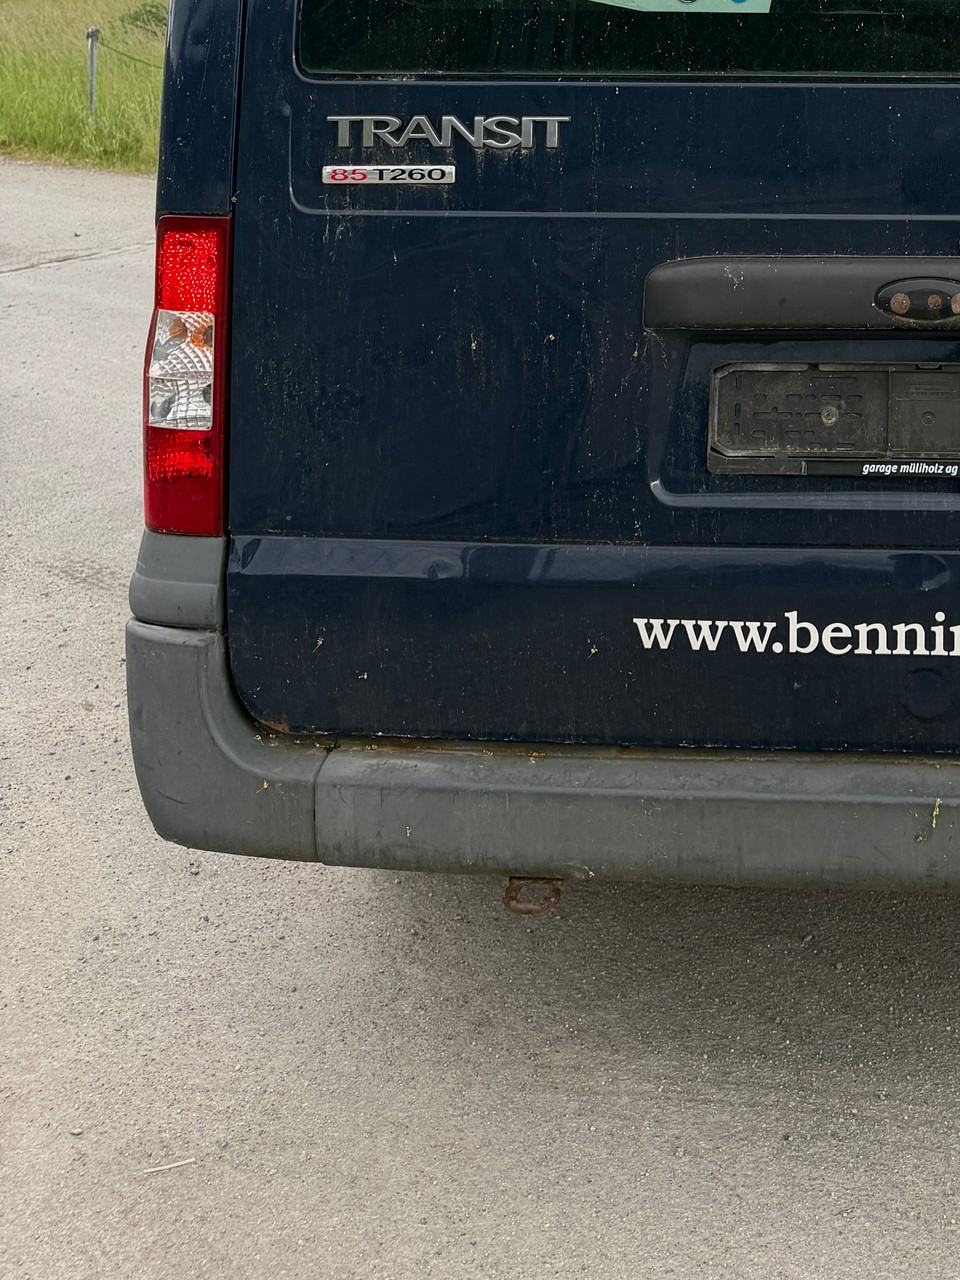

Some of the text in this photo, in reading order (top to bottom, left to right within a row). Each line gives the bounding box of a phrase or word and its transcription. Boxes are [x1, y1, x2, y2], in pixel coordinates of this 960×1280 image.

[326, 114, 572, 148] TRANSIT
[330, 168, 446, 181] 85 T260
[862, 463, 898, 475] garage
[899, 462, 944, 474] müliholz
[945, 464, 959, 476] ag
